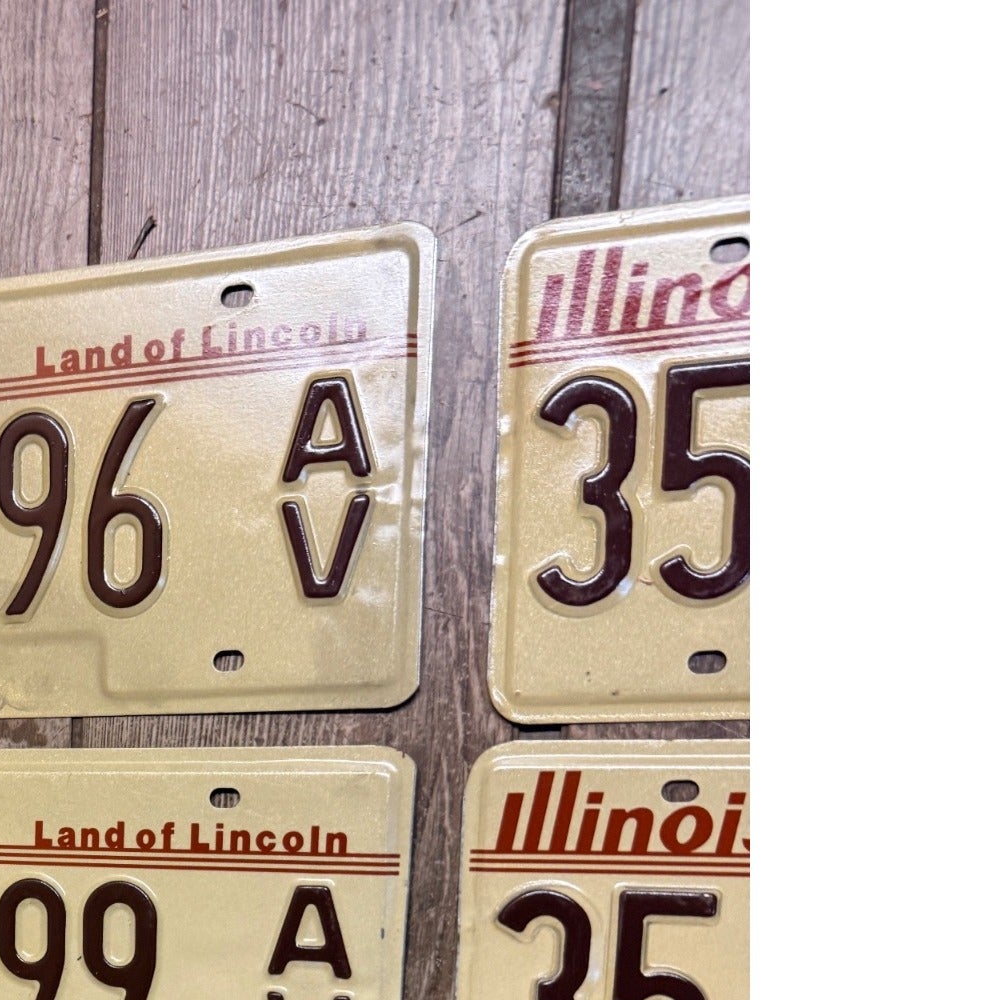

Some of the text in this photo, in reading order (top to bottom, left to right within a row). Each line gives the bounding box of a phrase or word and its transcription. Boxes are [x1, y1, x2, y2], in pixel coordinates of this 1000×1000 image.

[36, 335, 132, 376] Land
[144, 328, 185, 363] of
[202, 313, 368, 358] Lincoln
[537, 361, 750, 606] 35
[33, 819, 125, 850] Land
[138, 822, 175, 850] of
[191, 822, 349, 854] Lincoln
[495, 771, 750, 853] Illinoi
